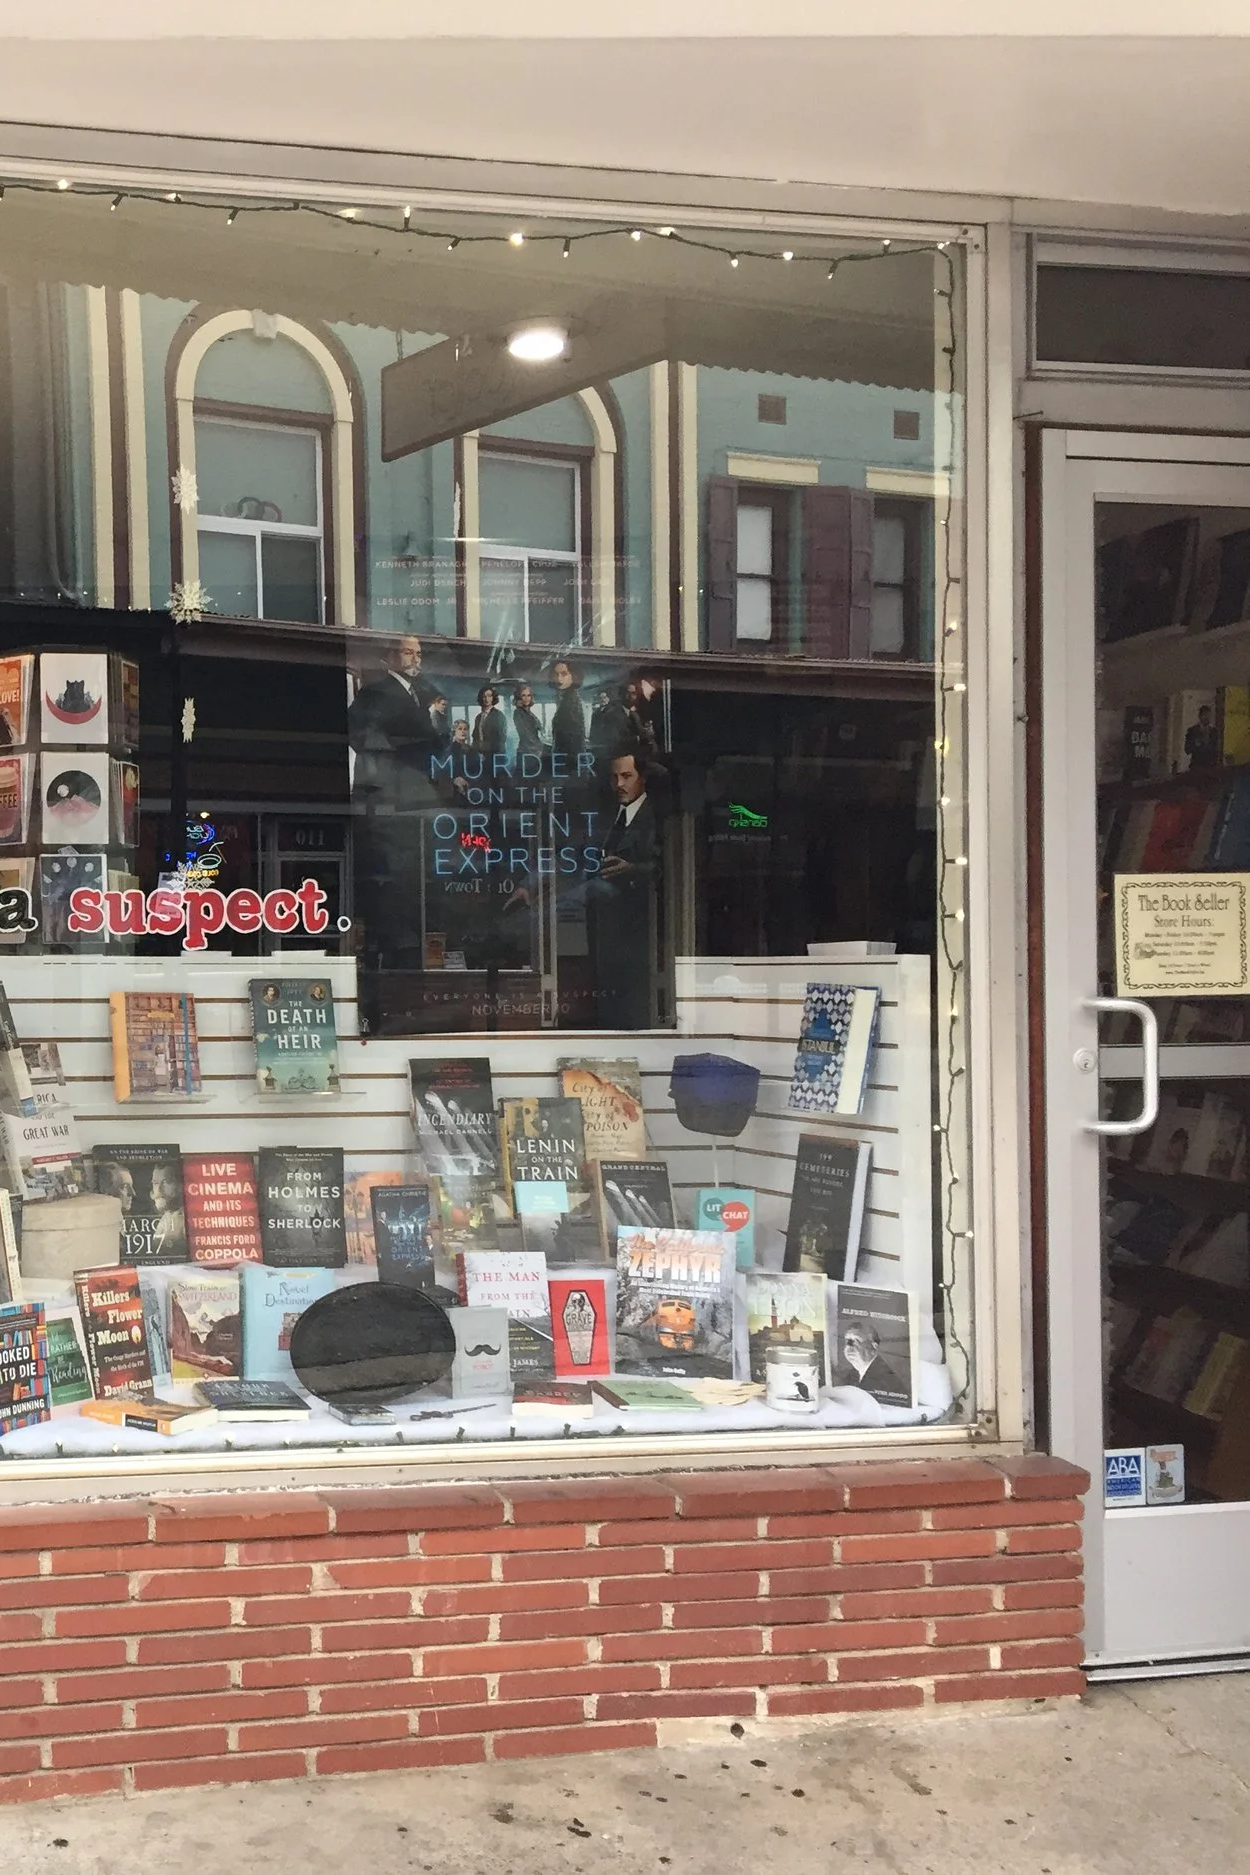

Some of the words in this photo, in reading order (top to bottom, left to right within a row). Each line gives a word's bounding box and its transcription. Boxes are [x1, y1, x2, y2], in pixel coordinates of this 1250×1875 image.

[430, 751, 598, 780] MURDER
[466, 786, 504, 806] ON
[514, 785, 564, 804] THE
[432, 811, 599, 841] ORIENT
[434, 845, 602, 876] EXPRESS
[1138, 893, 1160, 912] The
[1162, 893, 1192, 911] Book
[1194, 892, 1230, 912] Seller
[68, 878, 351, 951] suspect.
[1154, 915, 1178, 928] Store
[1181, 914, 1215, 928] Hours:
[267, 1009, 327, 1024] DEATH
[471, 1003, 551, 1016] NOVEMBER
[277, 1034, 323, 1049] HEIR
[572, 1082, 595, 1094] City
[418, 1112, 493, 1126] INCENDIARY
[23, 1125, 49, 1141] GREAT
[52, 1124, 70, 1139] WAR
[585, 1122, 629, 1132] POISON
[516, 1139, 577, 1153] LENIN
[546, 1155, 564, 1163] THE
[202, 1163, 236, 1176] LIVE
[516, 1166, 580, 1180] TRAIN
[629, 1164, 667, 1172] CENTRAL
[799, 1162, 851, 1177] CEMETERIES
[286, 1172, 322, 1181] FROM
[188, 1182, 254, 1196] CINEMA
[268, 1186, 341, 1199] HOLMES
[203, 1200, 223, 1211] AND
[226, 1199, 242, 1211] ITS
[297, 1204, 312, 1213] TO
[707, 1204, 721, 1212] LIT
[192, 1215, 255, 1228] TECHNIQUES
[722, 1210, 749, 1220] CHAT
[268, 1218, 341, 1229] SHERLOCK
[125, 1233, 166, 1255] 1917
[195, 1235, 232, 1246] FRANCIS
[233, 1234, 256, 1245] FORD
[195, 1248, 259, 1261] COPPOLA
[628, 1250, 722, 1285] ZEPHYR
[472, 1272, 503, 1282] THE
[509, 1271, 541, 1282] MAN
[279, 1281, 309, 1298] Novel
[516, 1291, 539, 1300] THE
[81, 1284, 91, 1318] Killers
[91, 1290, 130, 1308] Killers
[107, 1308, 143, 1324] Flower
[841, 1307, 869, 1318] ALFRED
[97, 1329, 129, 1347] Moon
[50, 1340, 78, 1354] RATHER
[512, 1358, 540, 1367] JAMES
[2, 1367, 18, 1382] TO
[19, 1364, 38, 1378] DIE
[49, 1361, 88, 1384] Reading
[104, 1382, 130, 1398] David
[129, 1378, 153, 1391] Grann
[12, 1399, 46, 1416] DUNNING
[1107, 1456, 1141, 1477] ABA
